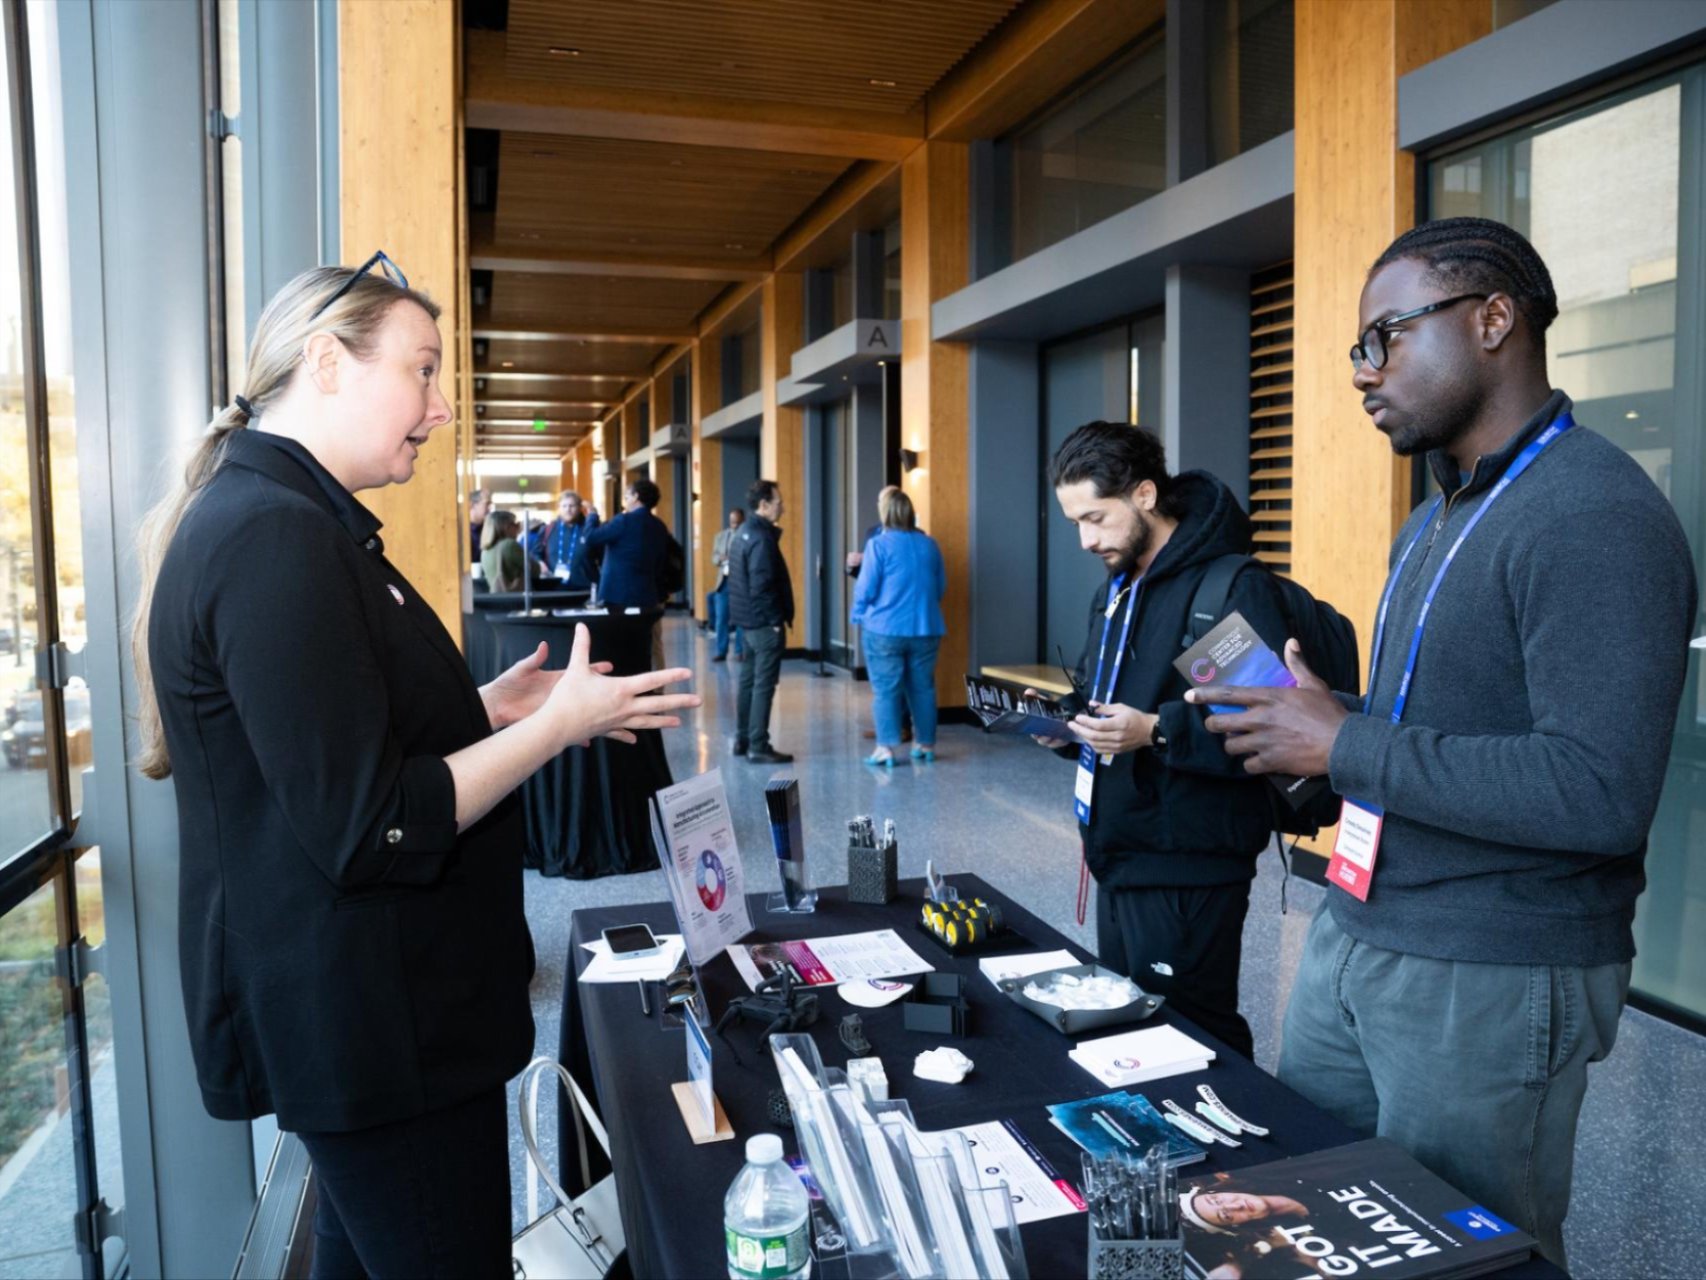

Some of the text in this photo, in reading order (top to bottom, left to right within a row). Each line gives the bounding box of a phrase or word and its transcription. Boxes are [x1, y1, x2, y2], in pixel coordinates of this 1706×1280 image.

[868, 325, 888, 348] A
[1327, 1185, 1442, 1258] MADE
[1274, 1224, 1358, 1276] GOT
[1347, 1245, 1404, 1268] IT
